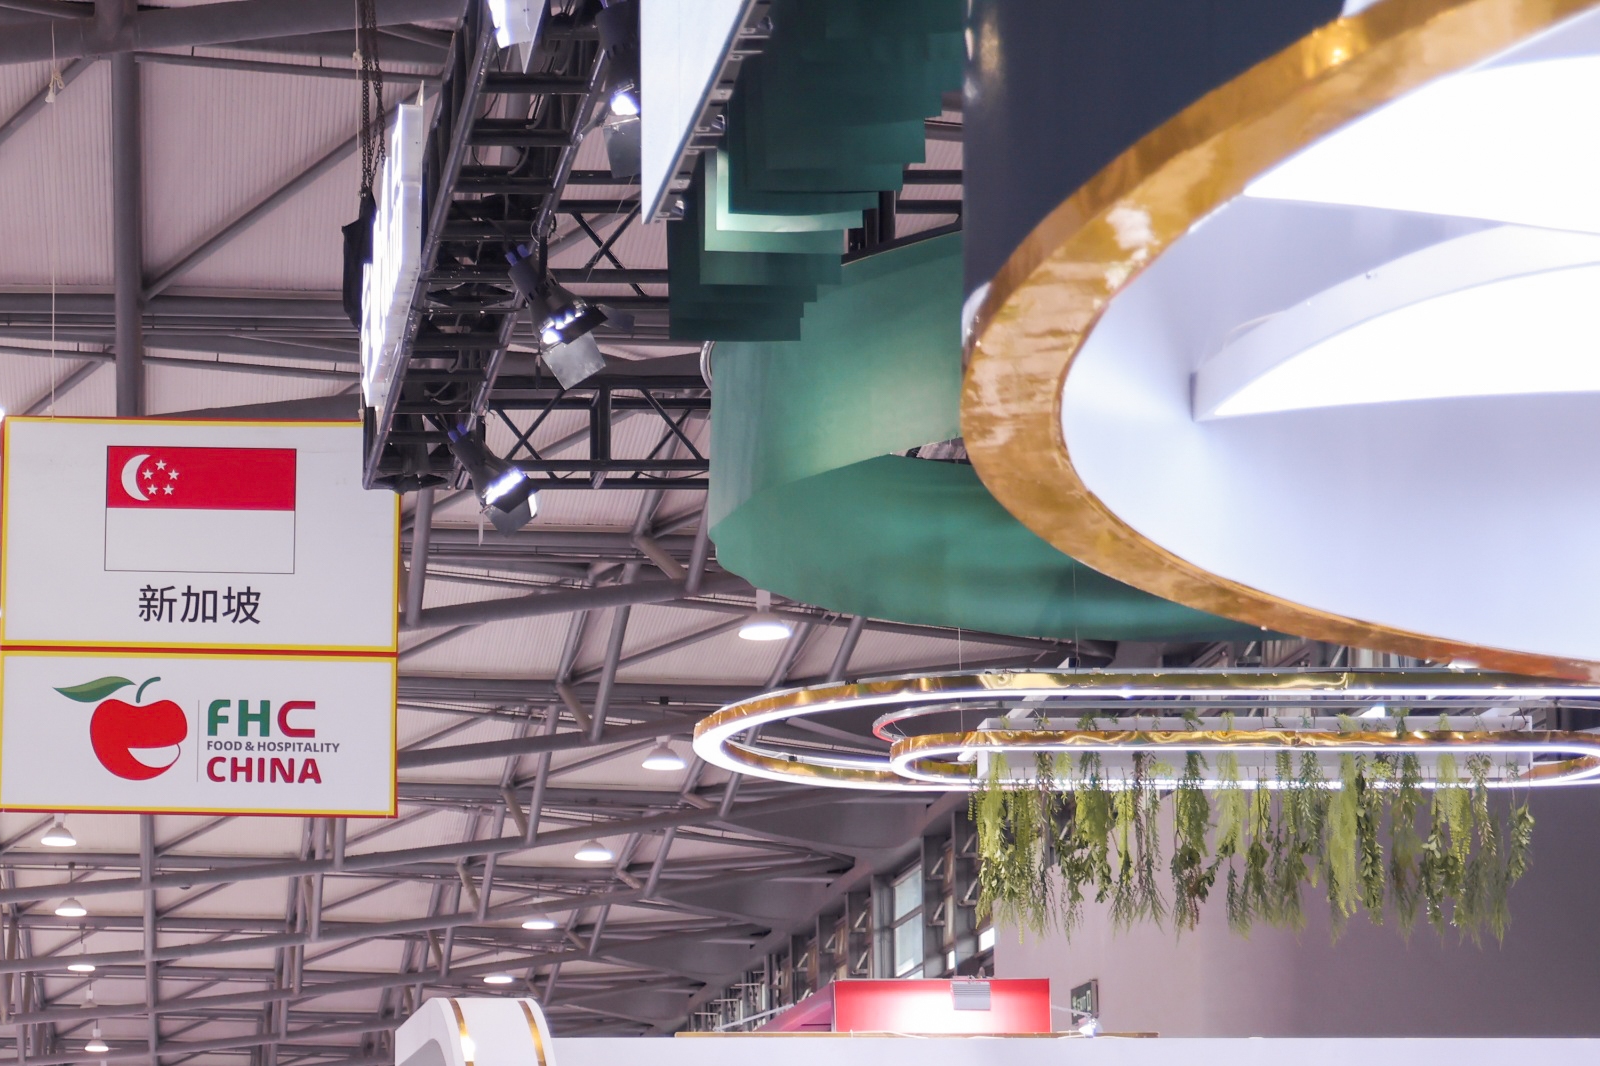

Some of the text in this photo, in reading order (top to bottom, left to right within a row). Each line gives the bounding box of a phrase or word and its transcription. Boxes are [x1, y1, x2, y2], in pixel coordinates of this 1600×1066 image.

[138, 585, 261, 625] 新加坡
[207, 698, 316, 737] FHC
[207, 740, 340, 754] FOOD & HOSPITALITY
[206, 756, 322, 784] CHINA
